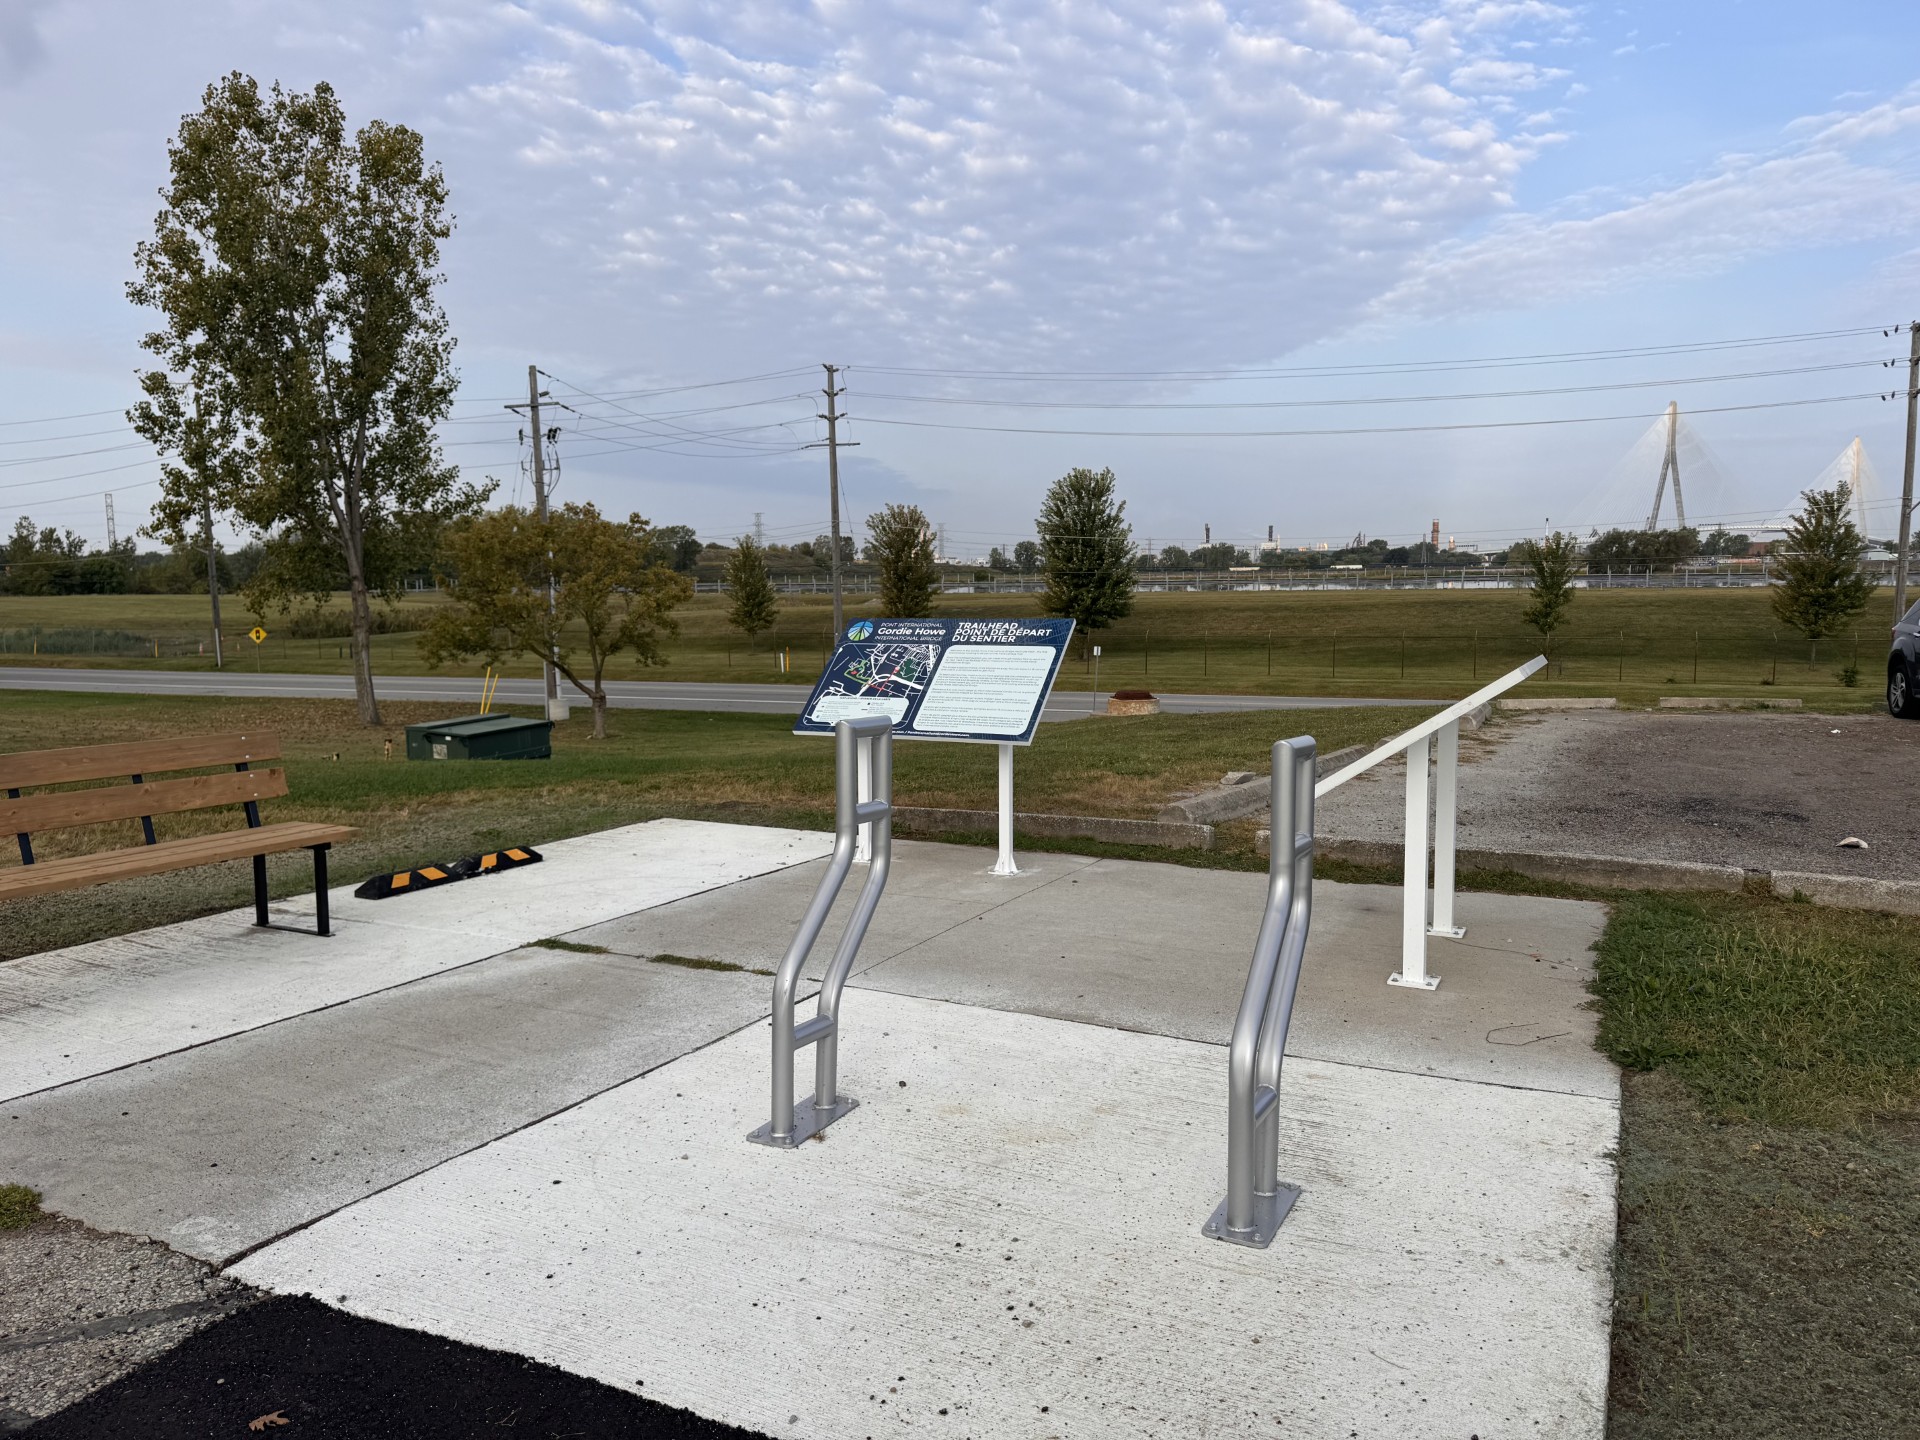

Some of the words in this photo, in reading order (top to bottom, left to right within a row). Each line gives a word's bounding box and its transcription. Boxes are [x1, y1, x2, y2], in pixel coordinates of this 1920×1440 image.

[877, 627, 912, 635] Gordie
[1007, 627, 1052, 636] DÉPART
[969, 635, 1016, 643] SENTIER
